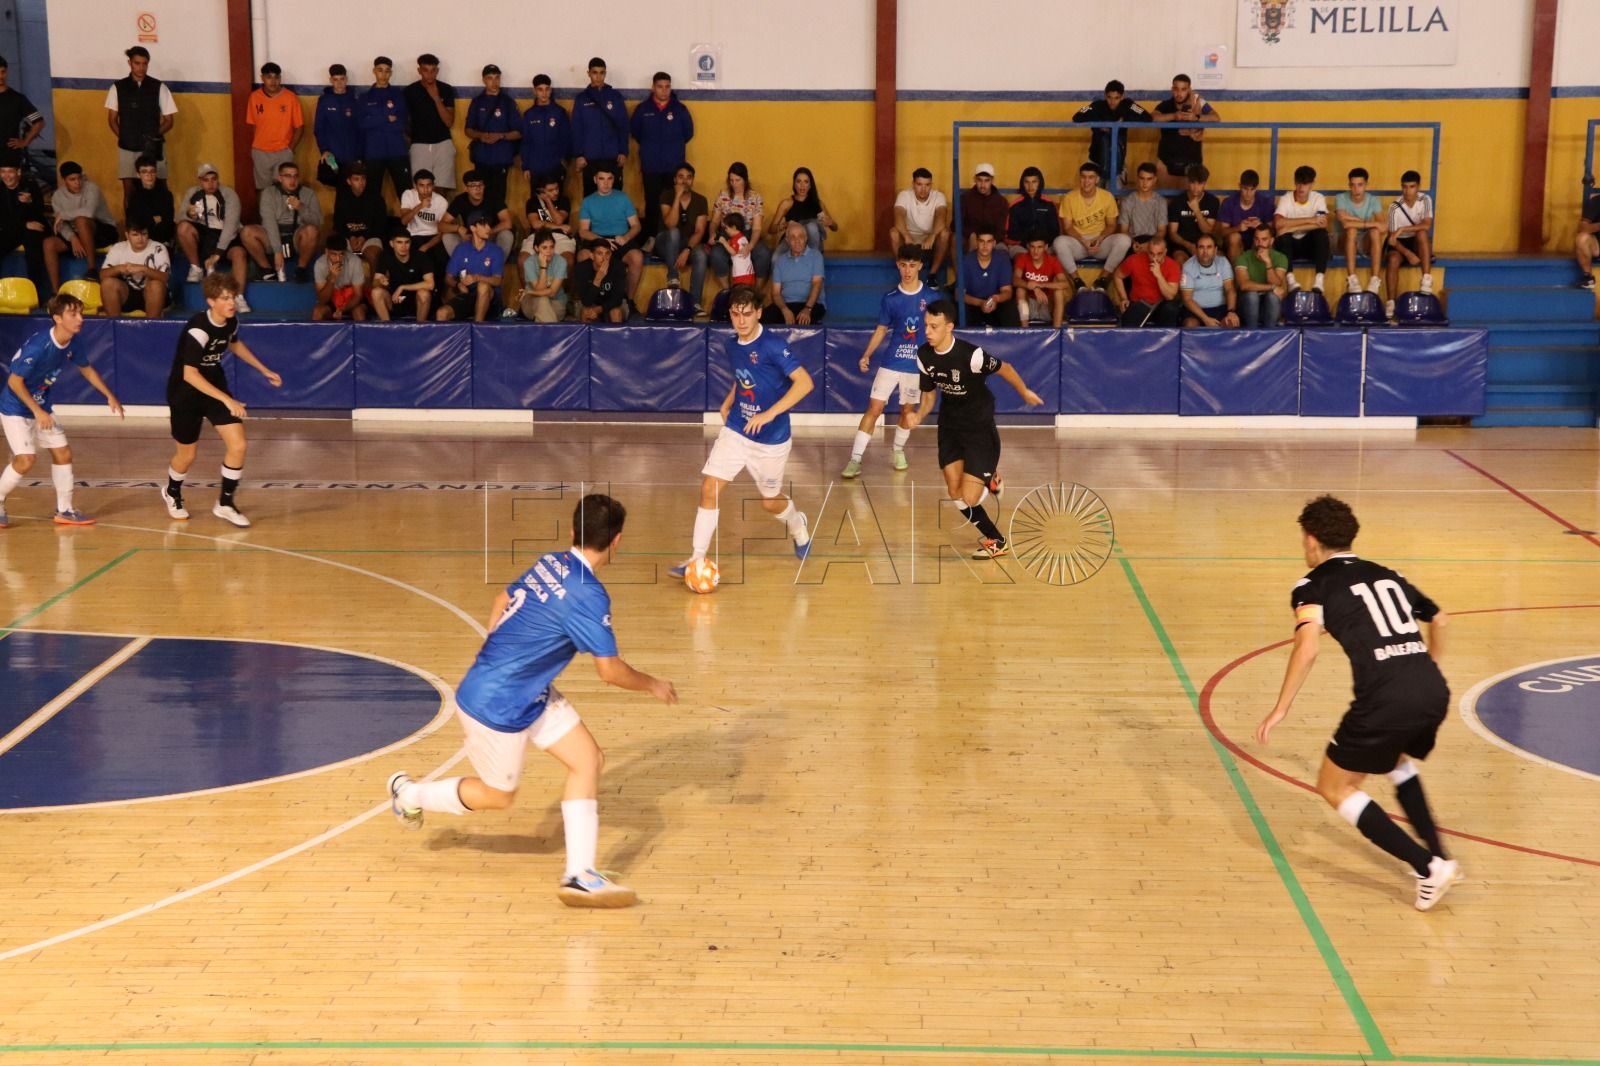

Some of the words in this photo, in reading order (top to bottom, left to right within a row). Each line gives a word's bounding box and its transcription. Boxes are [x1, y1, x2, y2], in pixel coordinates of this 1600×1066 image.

[1310, 5, 1449, 34] MELILLA
[1025, 271, 1049, 282] adidas
[1349, 578, 1420, 638] 10
